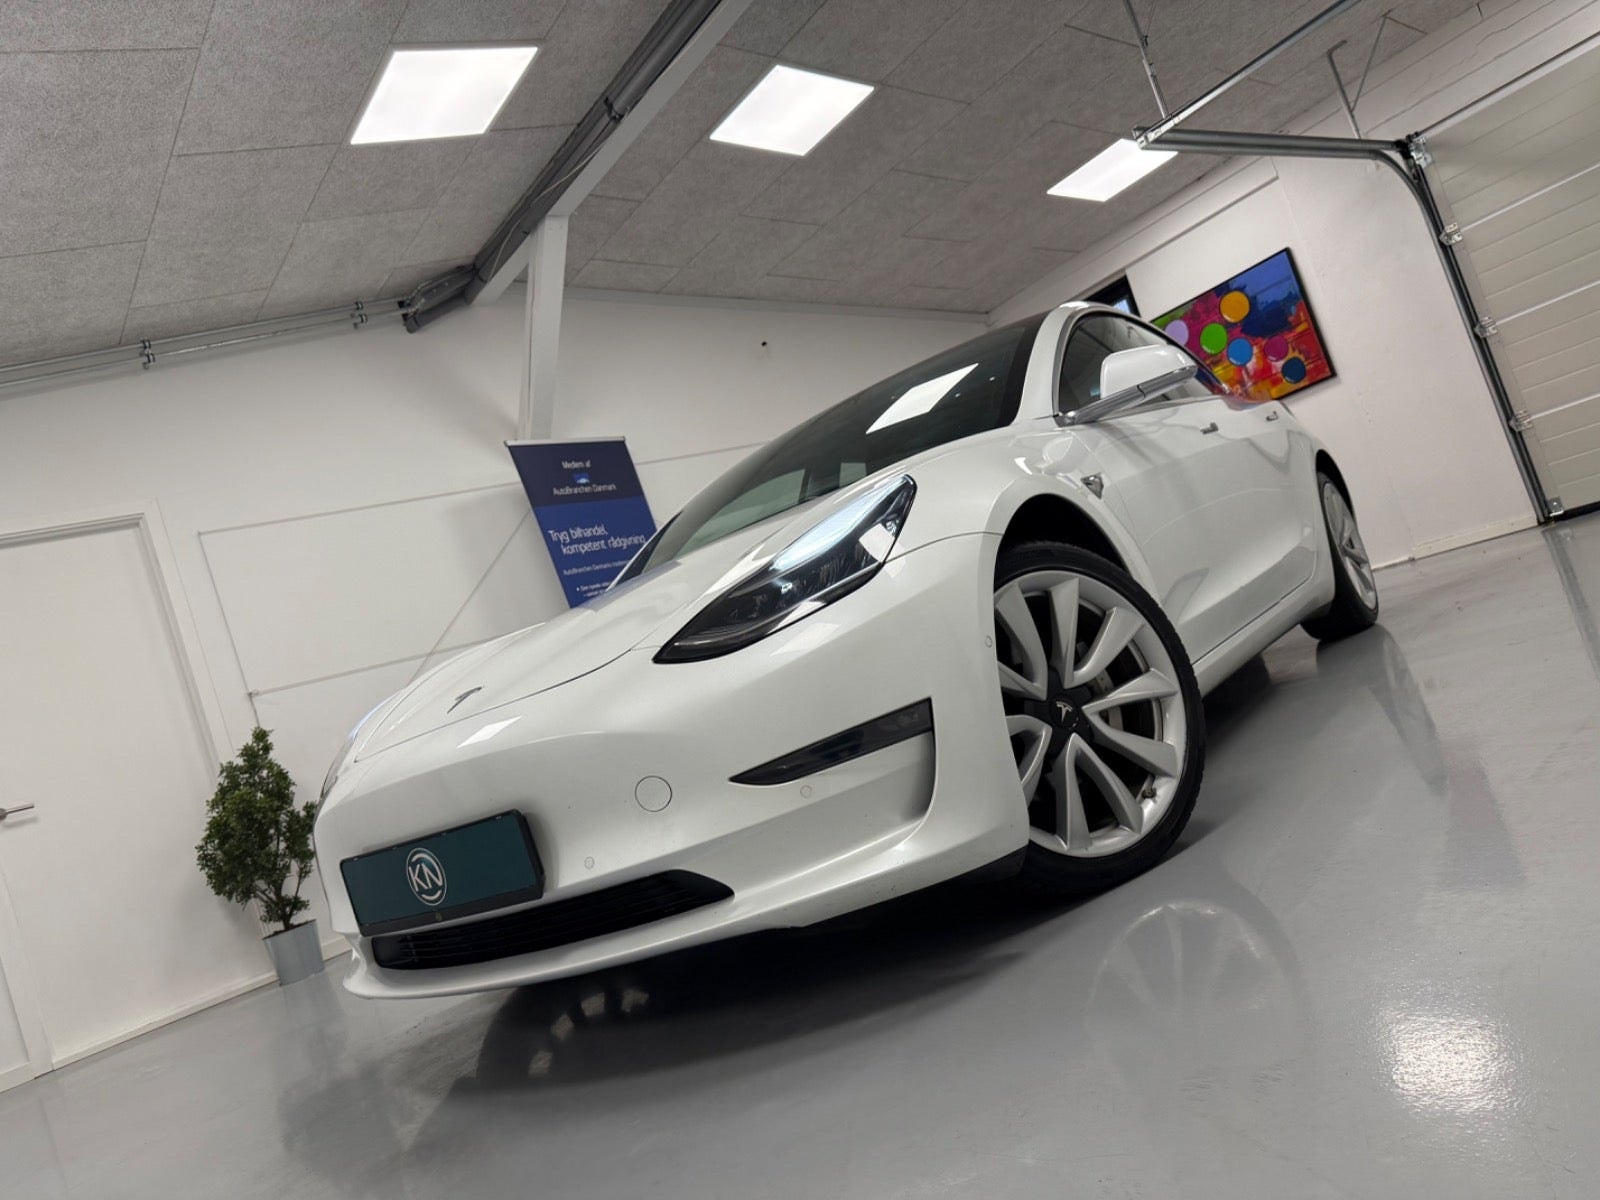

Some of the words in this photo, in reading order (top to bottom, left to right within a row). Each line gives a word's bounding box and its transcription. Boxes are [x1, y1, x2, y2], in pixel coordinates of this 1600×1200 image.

[548, 529, 570, 543] Tryg
[561, 540, 607, 555] kompetent
[409, 863, 443, 892] KN
